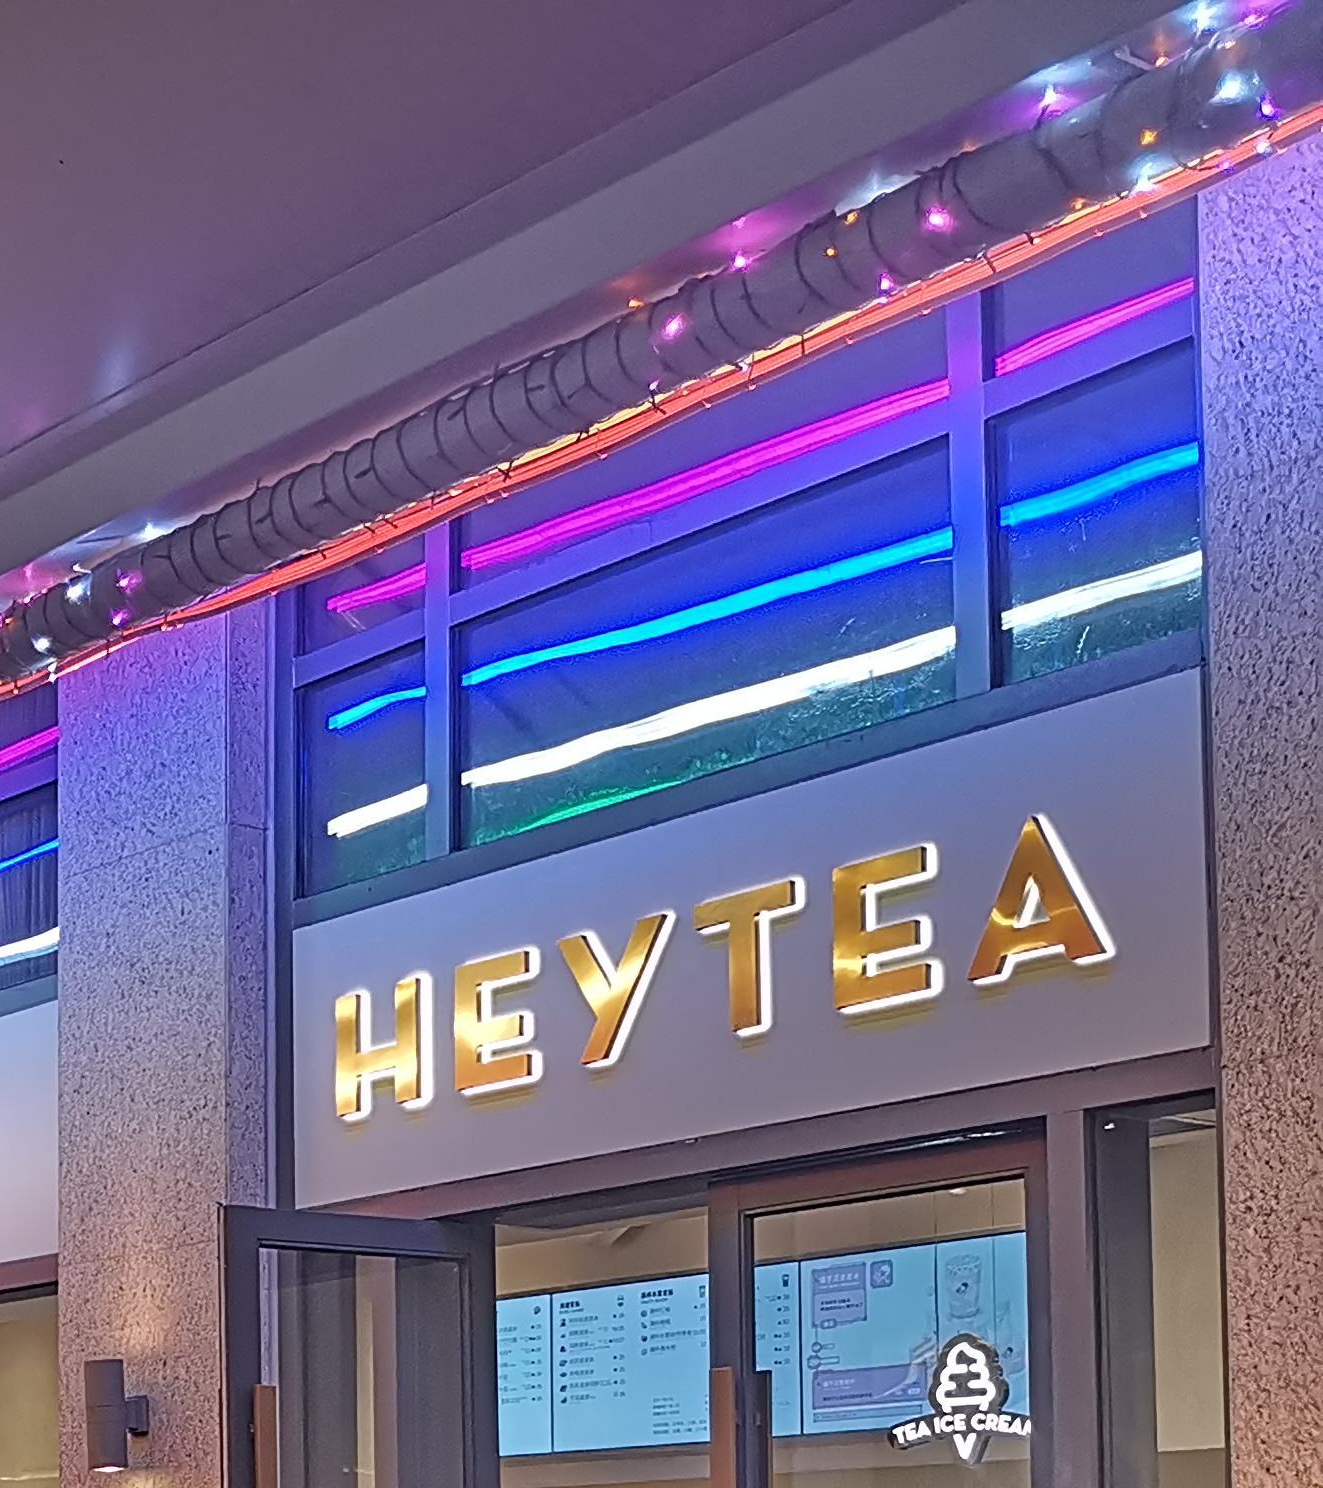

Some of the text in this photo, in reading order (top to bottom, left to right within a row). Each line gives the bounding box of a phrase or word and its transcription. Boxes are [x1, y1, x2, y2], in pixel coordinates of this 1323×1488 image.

[333, 813, 1115, 1122] HEYTEA
[892, 1423, 932, 1444] TEA
[933, 1413, 967, 1434] ICE
